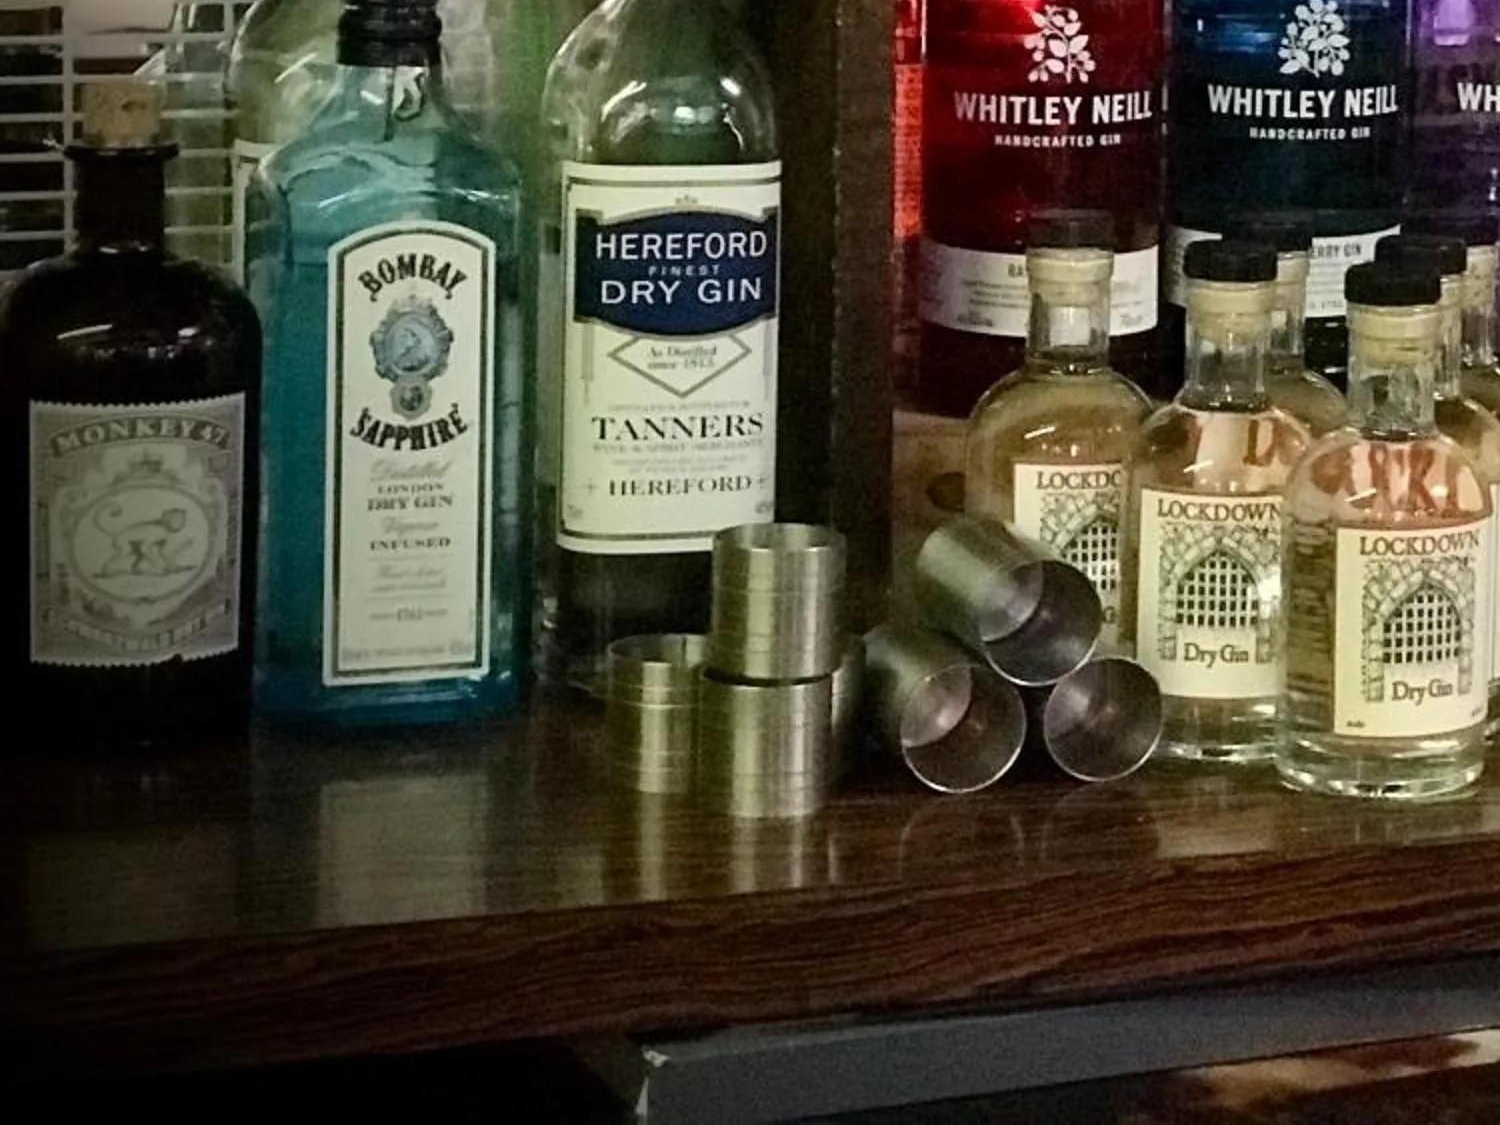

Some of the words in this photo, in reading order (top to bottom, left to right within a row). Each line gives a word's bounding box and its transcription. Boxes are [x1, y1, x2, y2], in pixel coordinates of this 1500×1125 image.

[954, 90, 1083, 126] WHITLEY
[1091, 89, 1153, 125] NEILL
[1207, 83, 1336, 119] WHITLEY
[1343, 84, 1399, 118] NEILL
[994, 133, 1095, 149] HANDCRAFTED
[1099, 132, 1122, 147] GIN
[1249, 126, 1347, 140] HANDCRAFTED
[1351, 125, 1371, 139] GIN
[596, 230, 768, 260] HEREFORD
[357, 252, 468, 303] BOMBAY
[648, 265, 721, 276] FINEST
[601, 279, 681, 305] DRY
[697, 277, 762, 304] GIN
[53, 416, 197, 452] MONKEY
[198, 425, 227, 444] 47
[349, 403, 471, 452] SAPPHIRE
[591, 412, 764, 441] TANNERS
[377, 482, 445, 495] LONDON
[608, 474, 752, 497] HEREFORD
[367, 496, 410, 511] DRY
[413, 493, 455, 510] GIN
[1157, 498, 1281, 523] LOCKDOWN
[369, 537, 451, 551] INFUSED
[1359, 527, 1480, 557] LOCKDOWN
[1184, 642, 1217, 668] Dry
[1220, 642, 1249, 663] Gin
[1391, 680, 1427, 707] Dry
[1428, 678, 1454, 698] Gin
